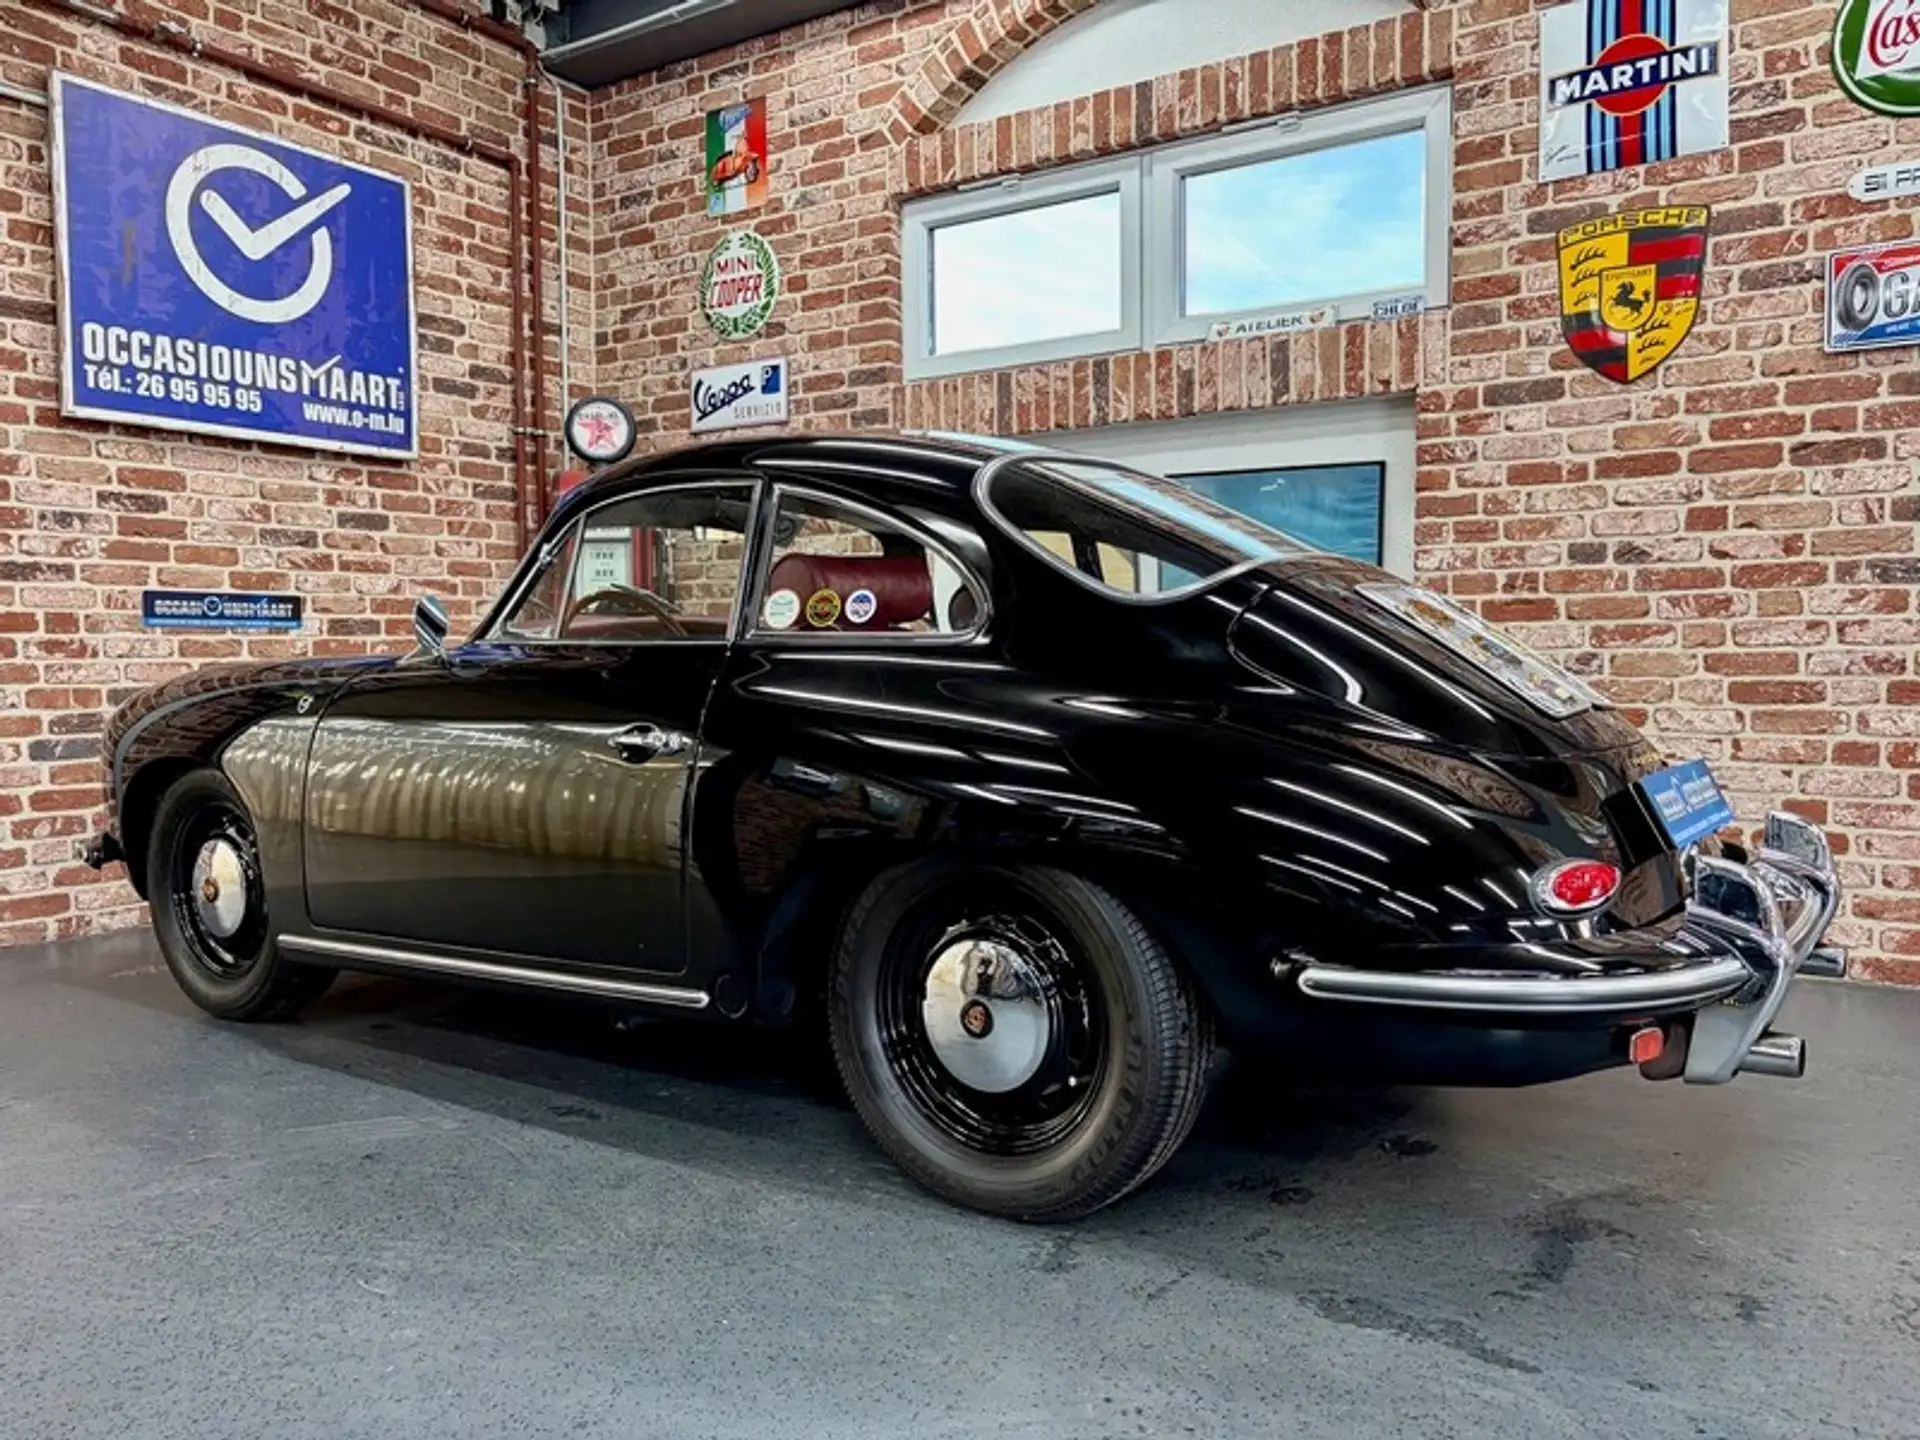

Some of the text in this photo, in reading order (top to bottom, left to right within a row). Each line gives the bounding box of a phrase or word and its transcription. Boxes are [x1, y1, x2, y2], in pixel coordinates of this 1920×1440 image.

[1554, 47, 1711, 107] MARTINI
[716, 253, 755, 275] MINI
[709, 273, 763, 309] COOPER
[1235, 314, 1303, 334] ATELIER
[136, 370, 166, 398] 26
[169, 377, 199, 405] 95
[202, 383, 232, 410] 95
[235, 388, 263, 414] 95
[694, 374, 756, 422] Vespa
[302, 401, 405, 436] www.o-m.lu
